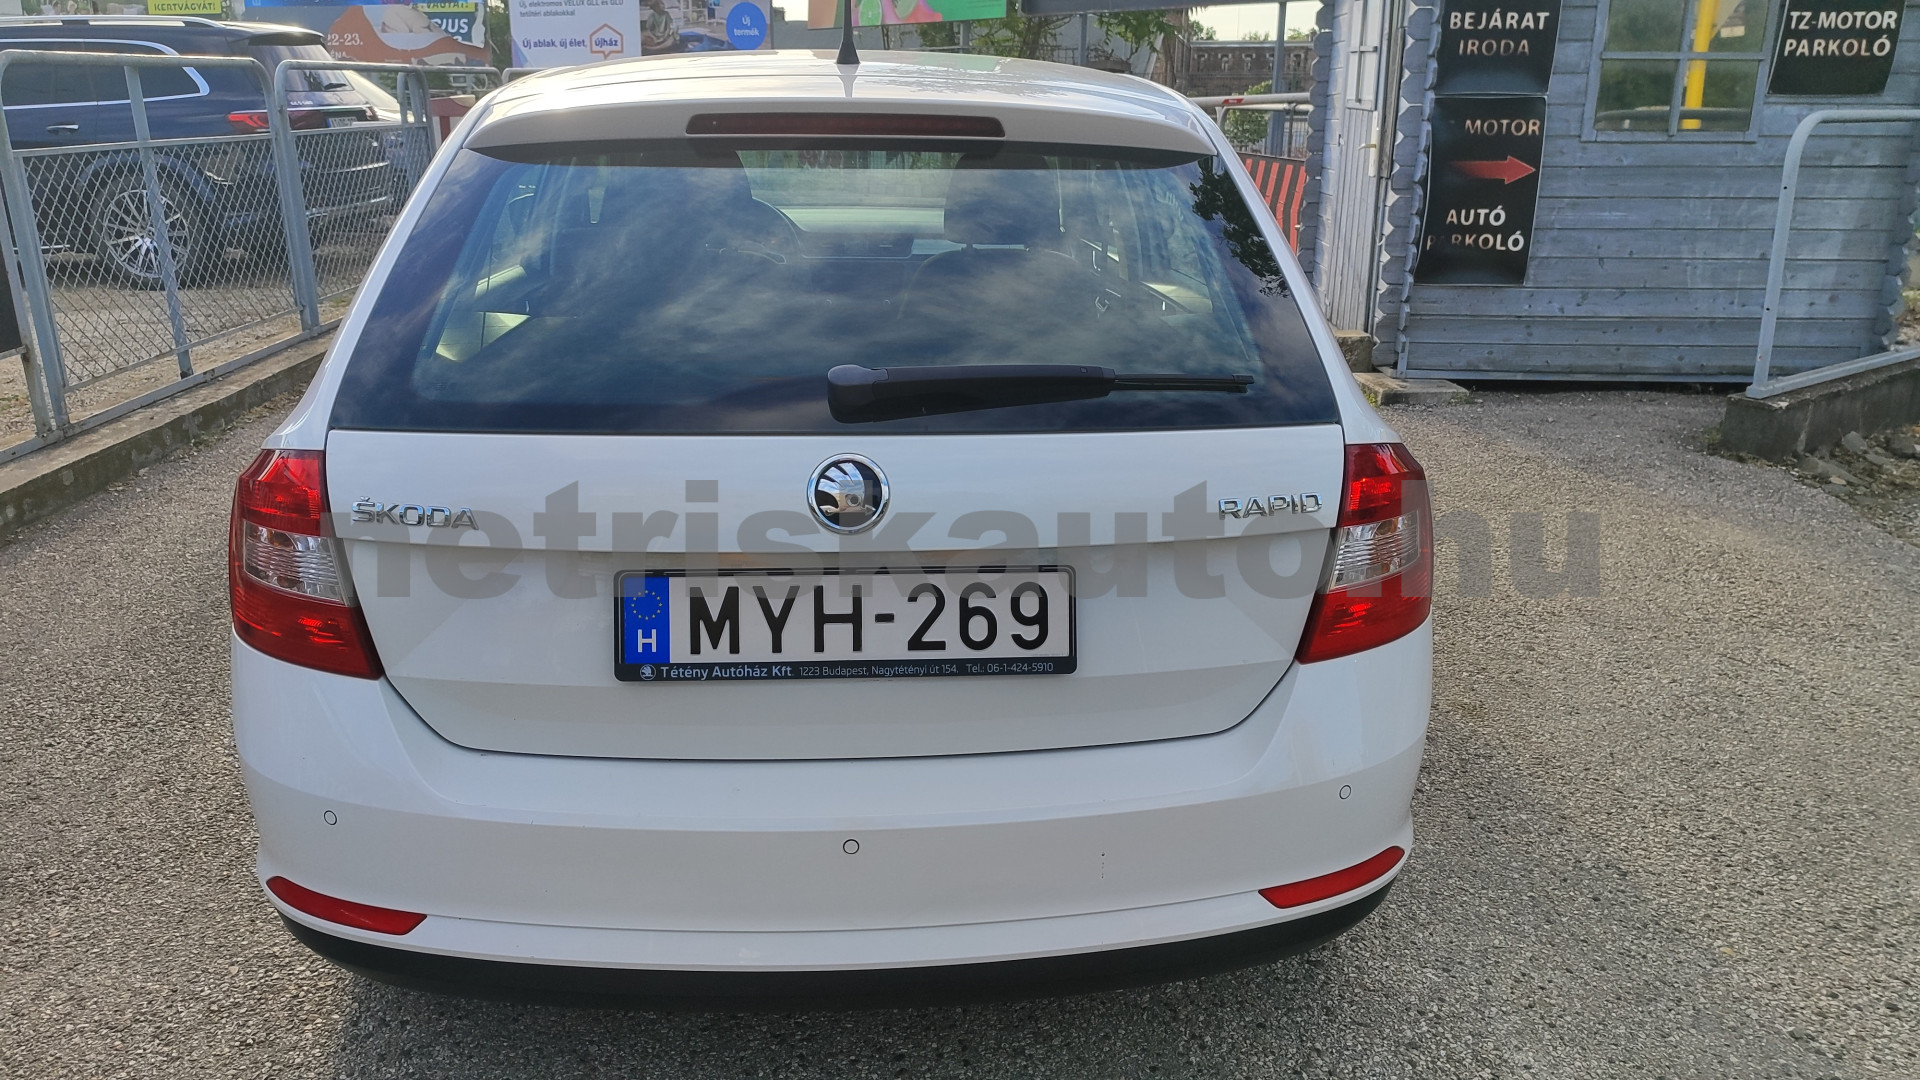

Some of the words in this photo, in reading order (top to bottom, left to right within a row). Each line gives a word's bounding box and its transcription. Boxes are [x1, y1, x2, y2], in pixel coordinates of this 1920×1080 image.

[154, 1, 216, 11] KERTVÁGYÁT!
[742, 15, 751, 26] Új
[1449, 8, 1551, 30] BEJÁRAT
[1789, 10, 1898, 30] TZ-MOTOR
[733, 28, 760, 37] termék
[522, 37, 532, 50] Új
[1458, 39, 1530, 56] IRODA
[1783, 35, 1891, 57] PARKOLÓ
[1464, 119, 1541, 136] MOTOR
[1446, 205, 1506, 227] AUTÓ
[1426, 230, 1525, 252] PRKOLÓ
[351, 496, 479, 531] ŠKODA
[1218, 492, 1322, 520] RAPID
[689, 581, 1050, 655] MYH-269
[637, 629, 657, 653] H
[660, 664, 708, 681] Tétény
[711, 664, 768, 678] Autóház
[799, 666, 820, 676] 1223
[822, 664, 869, 678] Budapest,
[871, 664, 927, 678] Nagytétényi
[929, 664, 940, 674] út
[941, 664, 959, 674] 154.
[966, 663, 985, 673] Tel.:
[986, 662, 1054, 673] 06-1-424-5910
